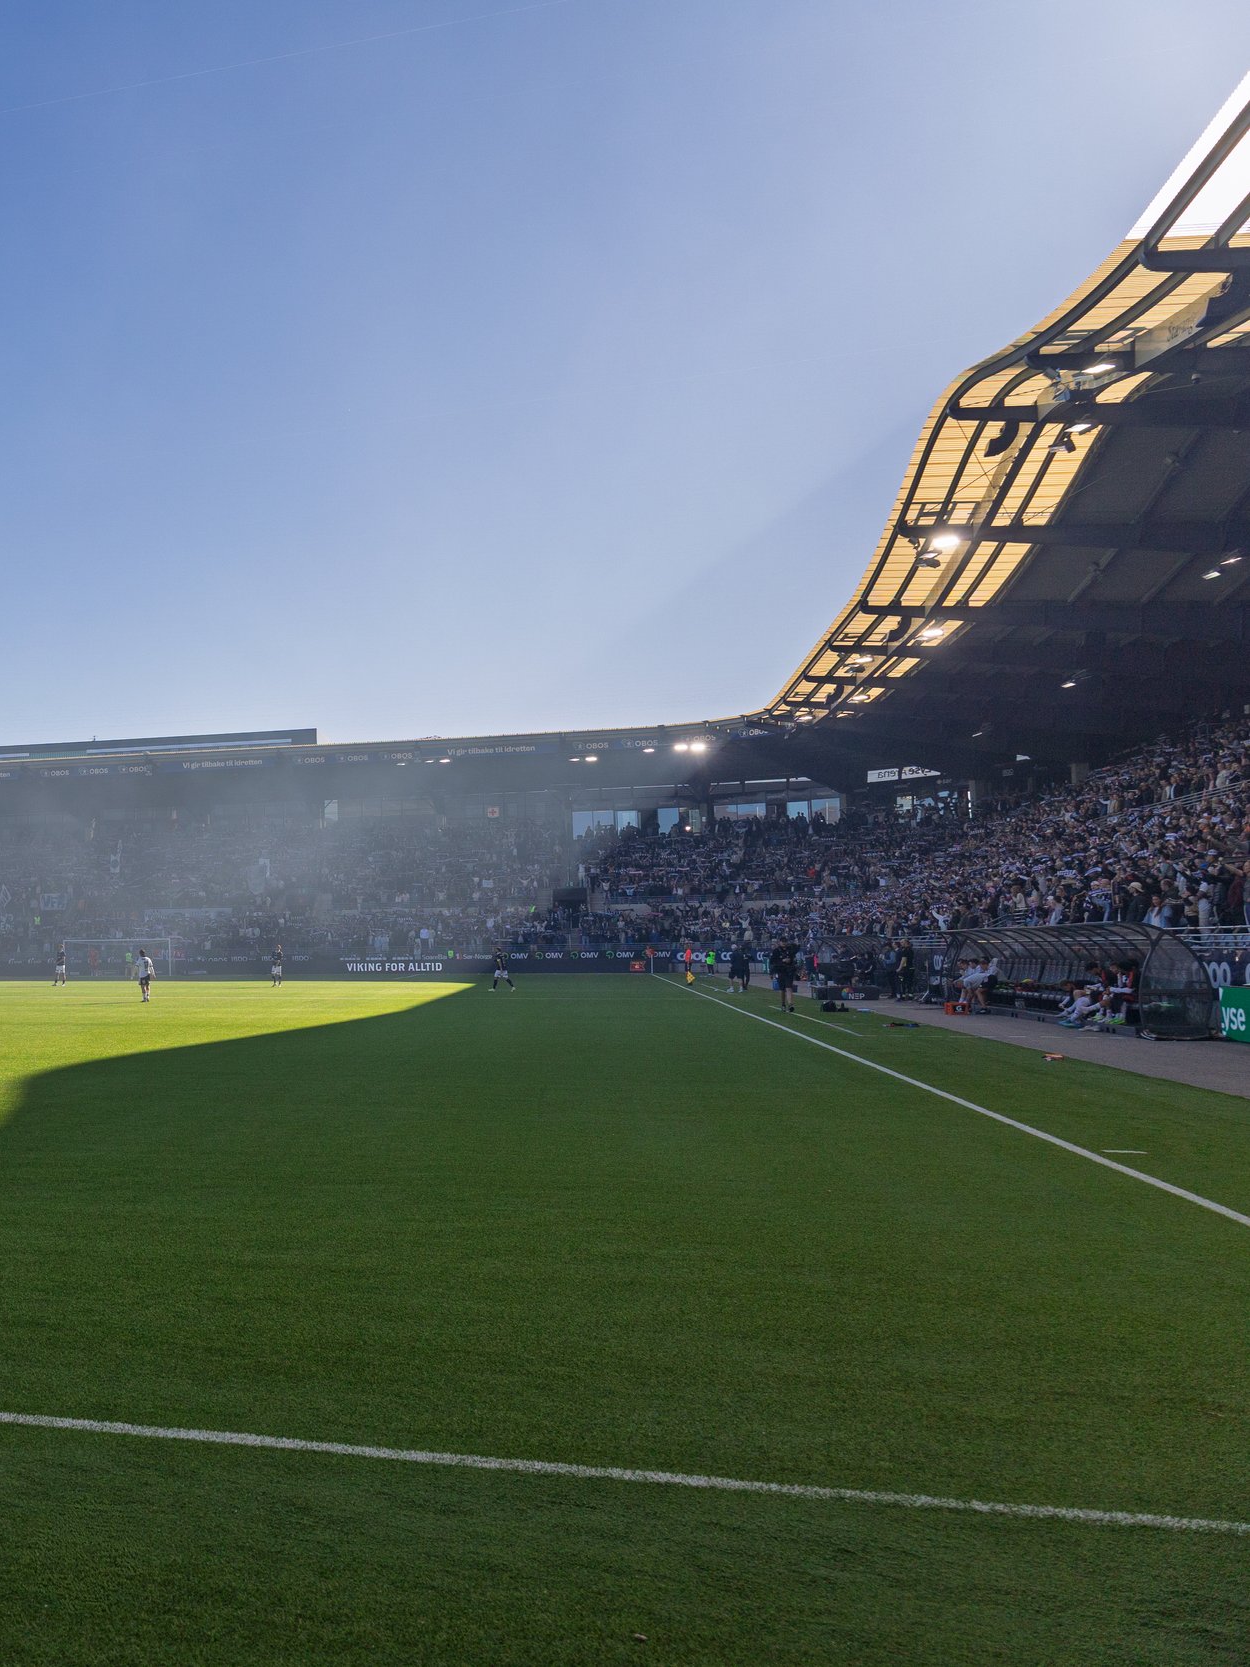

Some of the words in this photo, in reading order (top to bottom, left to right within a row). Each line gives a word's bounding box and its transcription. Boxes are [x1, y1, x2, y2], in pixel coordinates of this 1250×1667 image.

[635, 739, 659, 747] OBOS
[202, 760, 226, 768] tilbake
[234, 758, 263, 766] idretten
[581, 951, 599, 959] OMV
[346, 962, 382, 972] VIKING
[385, 962, 405, 972] FOR
[408, 962, 443, 972] ALLTID
